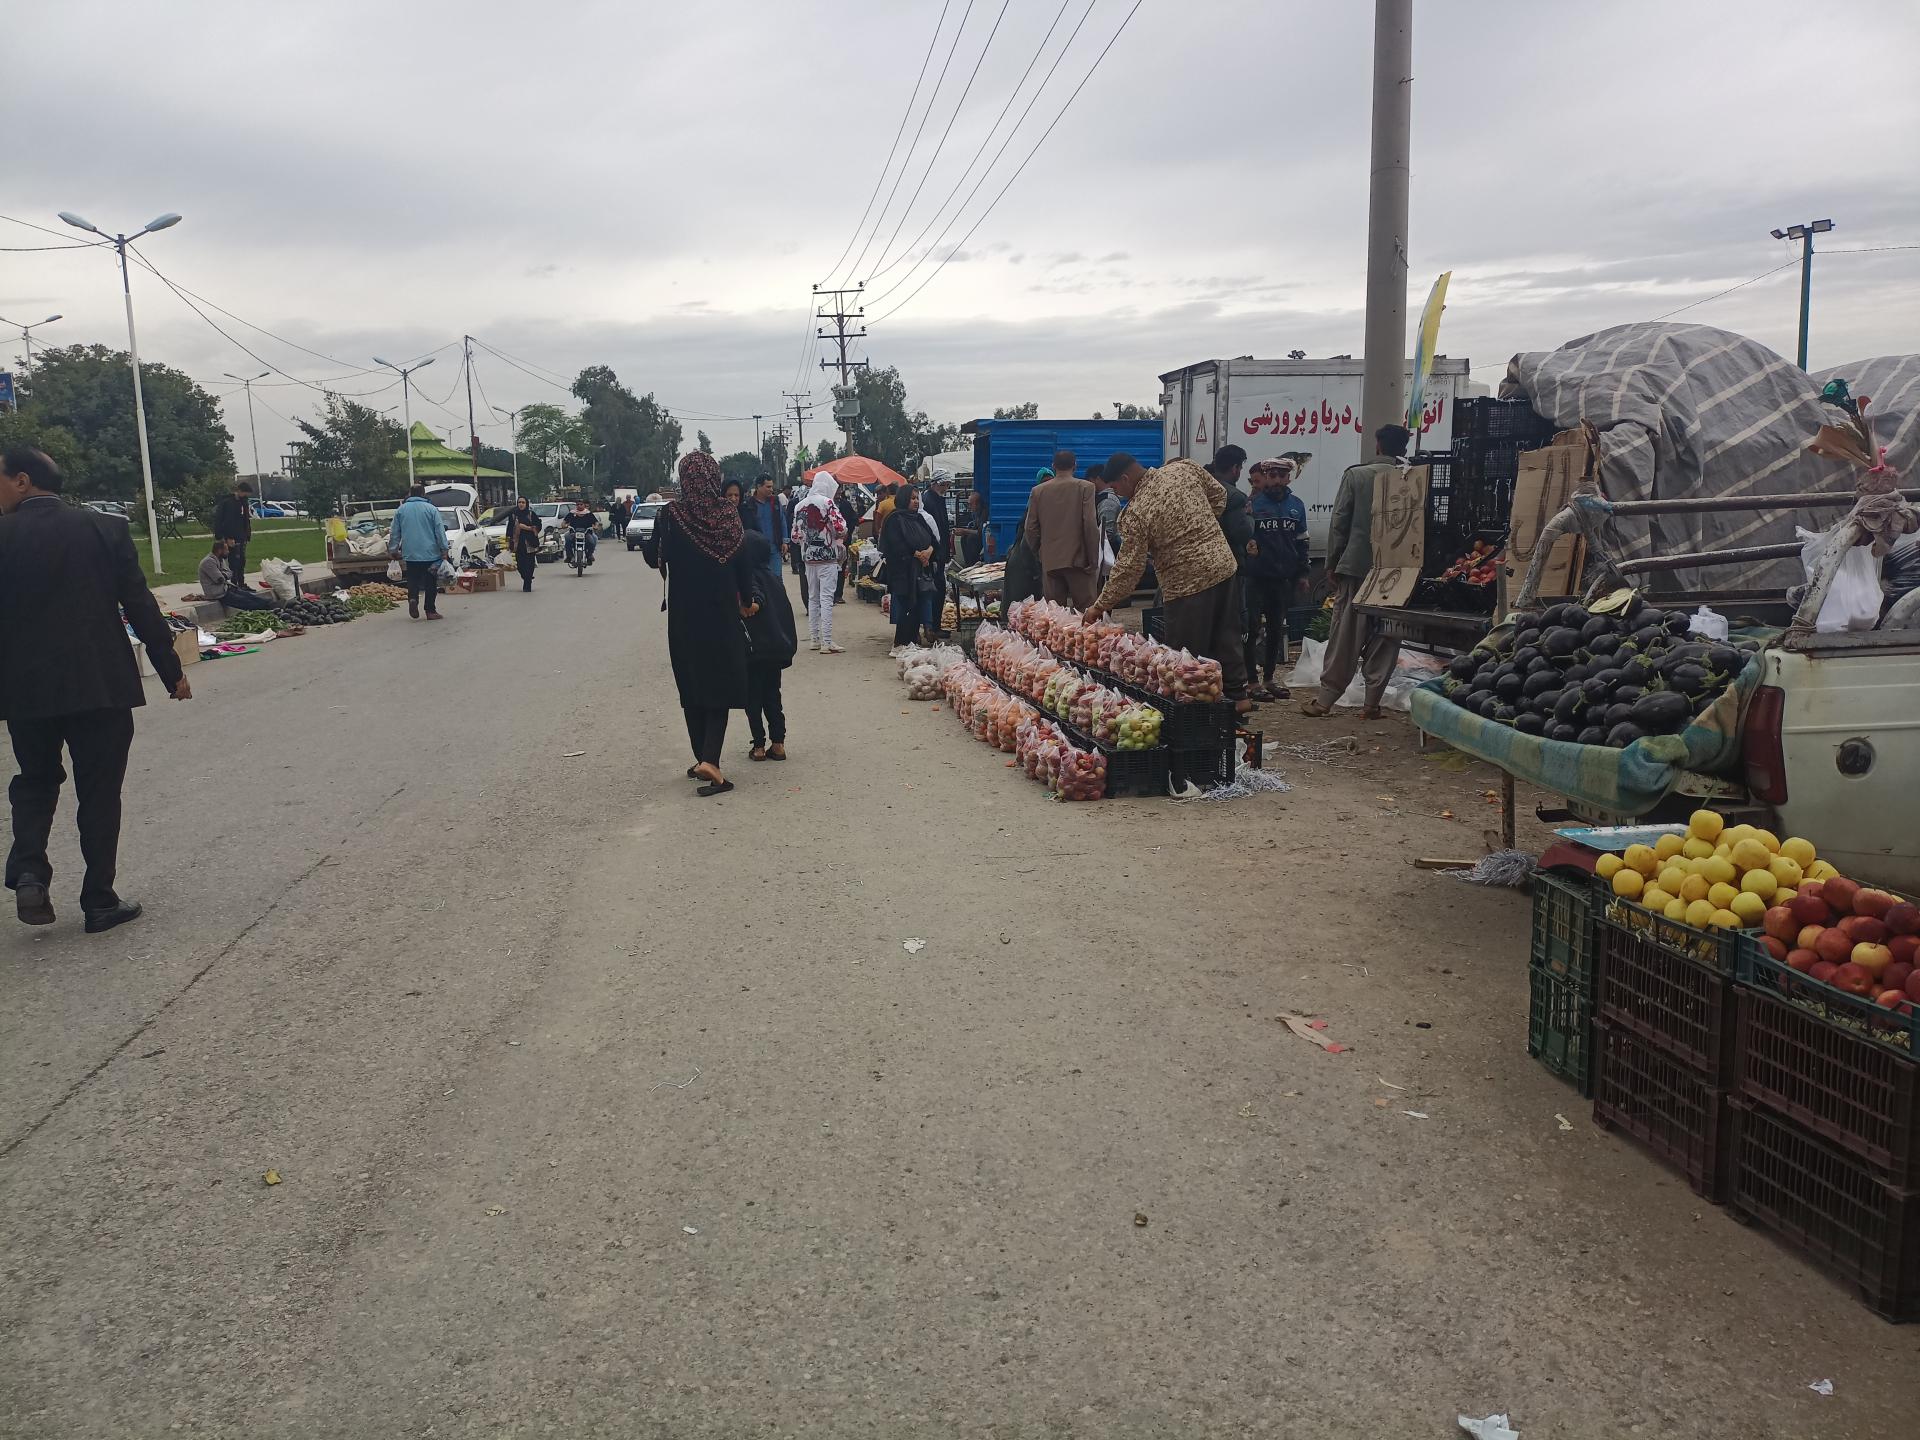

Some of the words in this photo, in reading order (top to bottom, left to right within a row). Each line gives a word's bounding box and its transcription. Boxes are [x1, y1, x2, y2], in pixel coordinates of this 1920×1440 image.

[1243, 402, 1307, 436] پرورشی
[1308, 410, 1319, 434] و
[1321, 398, 1352, 434] دریا
